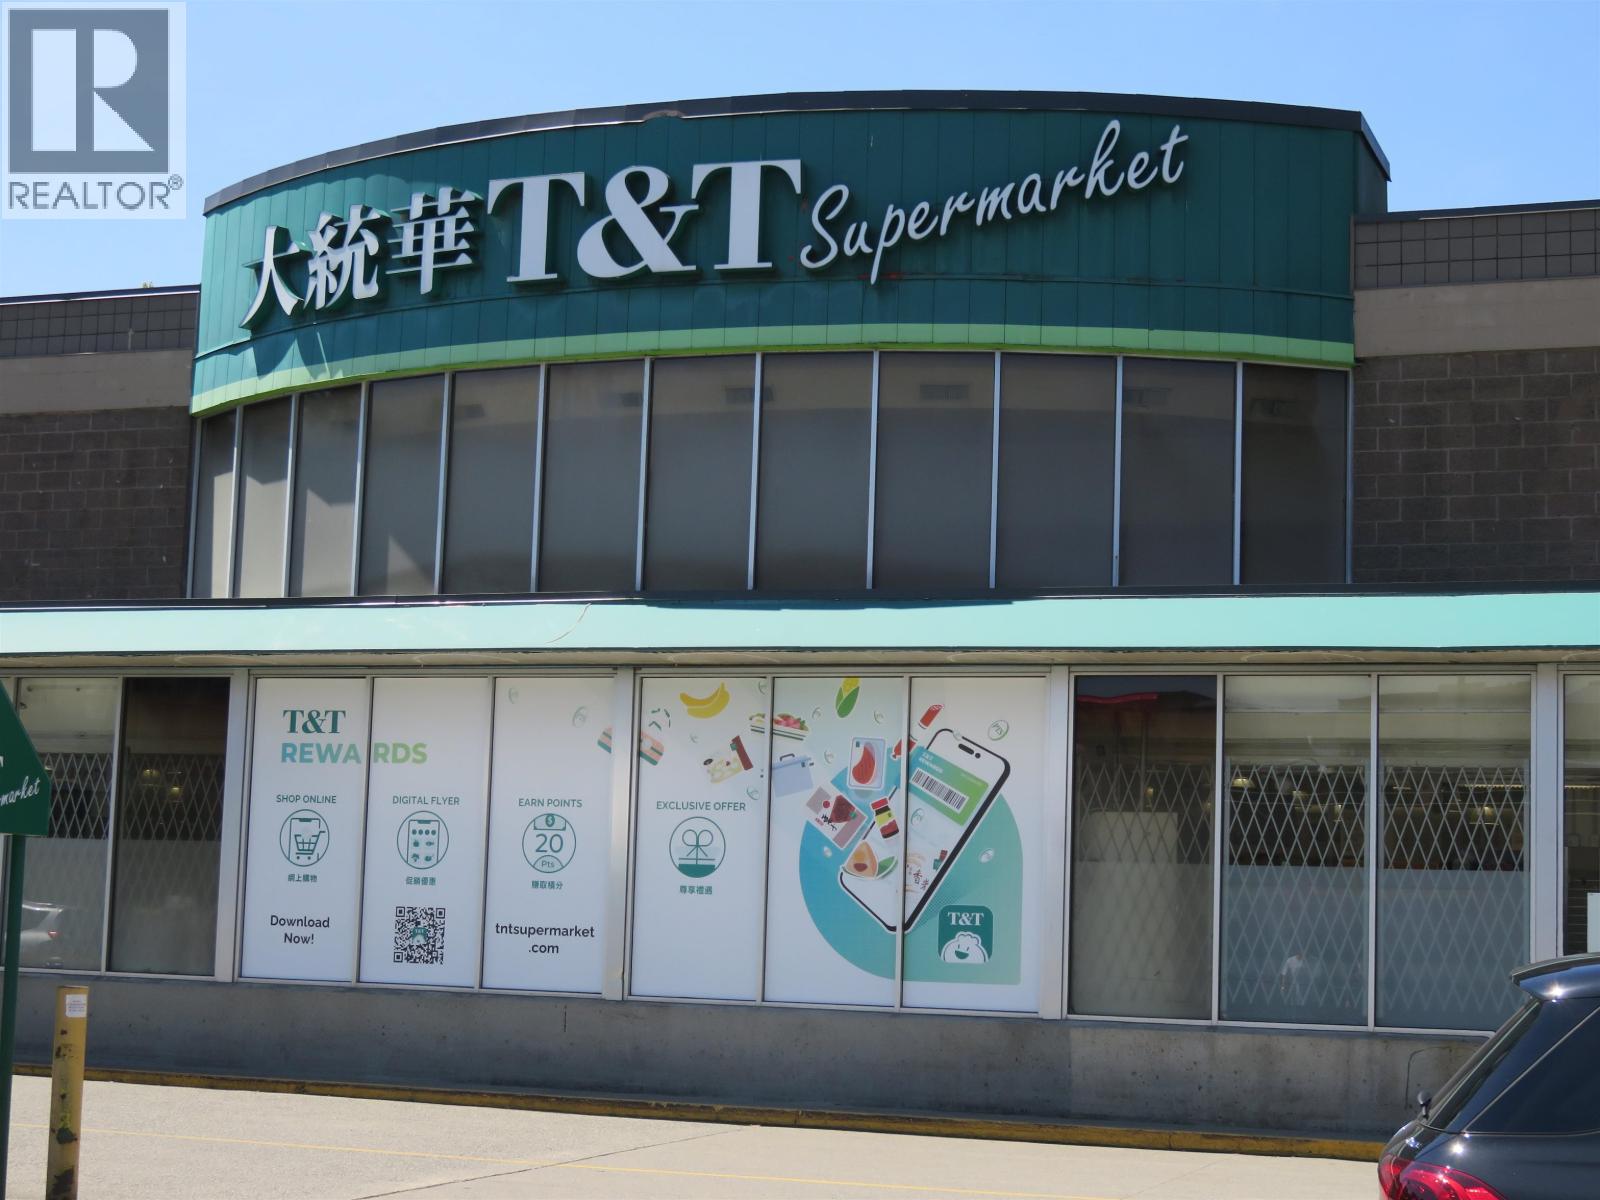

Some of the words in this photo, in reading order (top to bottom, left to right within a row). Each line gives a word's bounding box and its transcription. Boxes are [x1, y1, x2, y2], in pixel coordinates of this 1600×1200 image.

[486, 158, 804, 284] T&T
[800, 119, 1189, 285] Supermarket
[239, 187, 478, 329] 大統華
[282, 709, 347, 734] T&T
[0, 776, 41, 807] market
[276, 794, 301, 804] SHOP
[303, 795, 337, 804] ONLINE
[392, 795, 429, 805] DIGITAL
[431, 796, 460, 806] FLYER
[518, 798, 545, 807] EARN
[547, 798, 583, 808] POINTS
[656, 800, 711, 811] EXCLUSIVE
[713, 801, 746, 812] OFFER
[535, 833, 564, 853] 20
[541, 860, 555, 868] Pts
[270, 914, 330, 928] Download
[947, 911, 985, 926] T&T
[495, 922, 595, 939] tntsupermarket
[284, 932, 314, 945] Now!
[528, 944, 559, 954] .com
